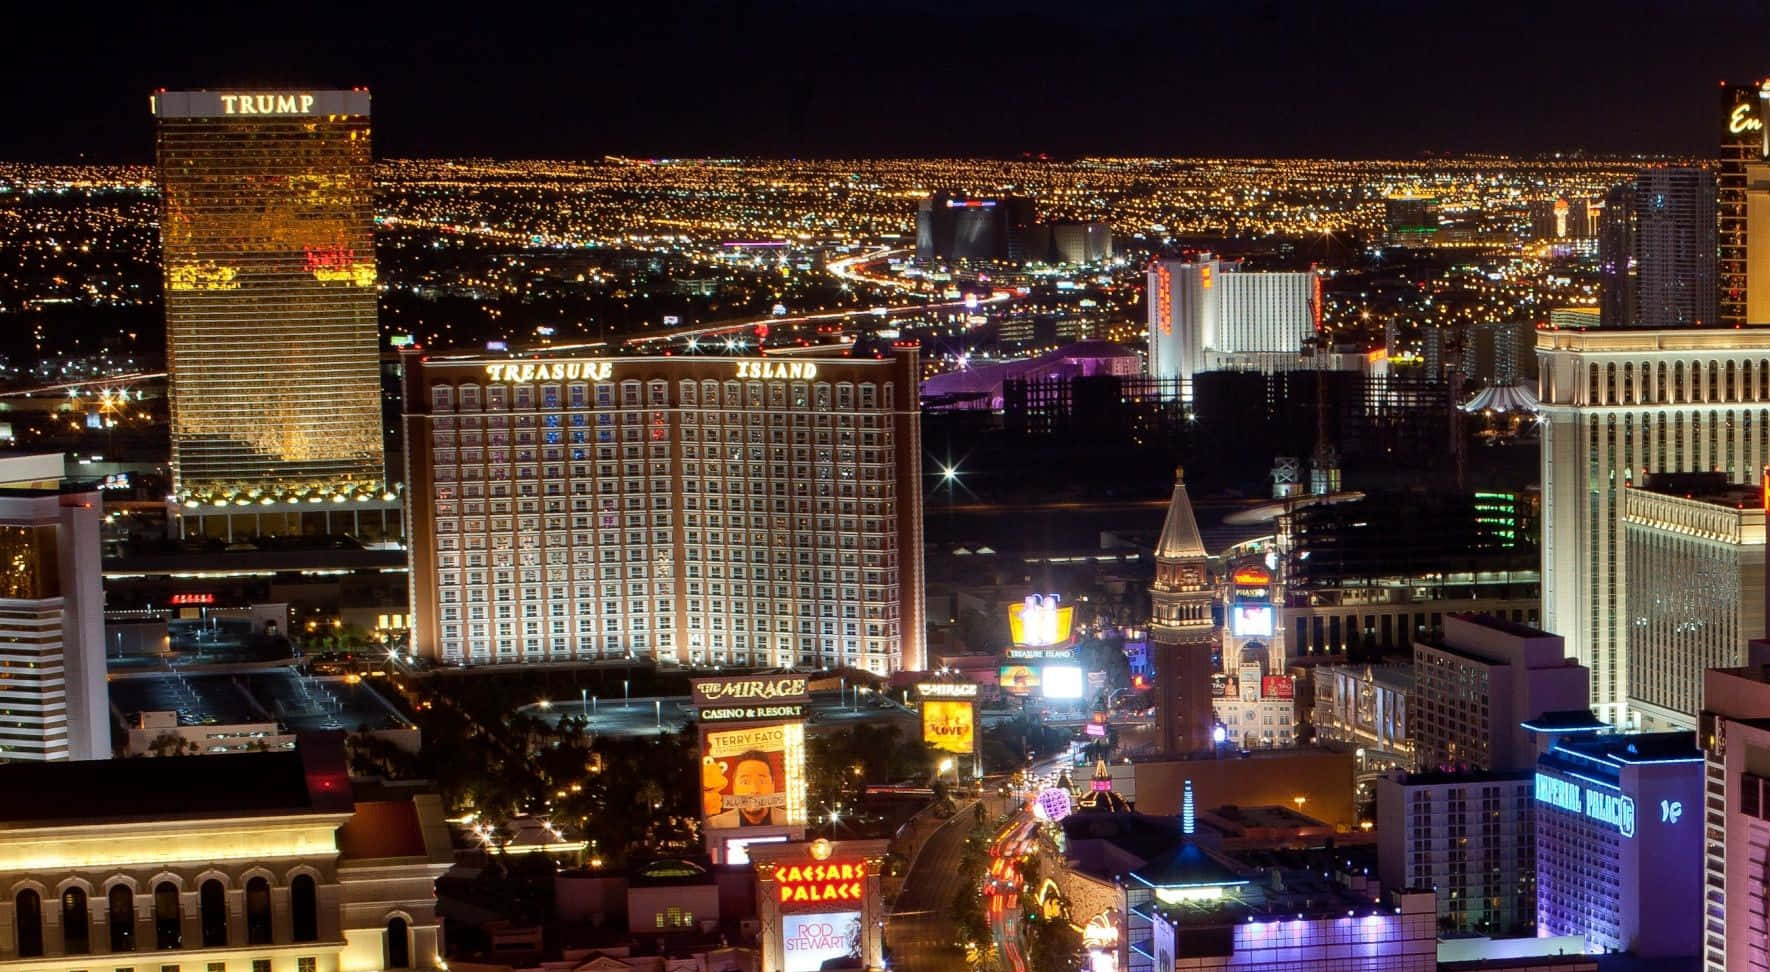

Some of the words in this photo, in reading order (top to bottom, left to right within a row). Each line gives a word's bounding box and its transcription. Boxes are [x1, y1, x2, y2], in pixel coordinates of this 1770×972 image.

[221, 95, 313, 114] TRUMP
[485, 362, 613, 382] TREASURE
[736, 361, 817, 379] ISLAND
[721, 680, 805, 699] MIRAGE
[702, 708, 744, 719] CASINO
[746, 709, 755, 718] &
[757, 706, 802, 717] RESORT
[715, 734, 751, 746] TERRY
[755, 730, 784, 741] FATO
[936, 726, 962, 736] LOVE
[1535, 773, 1582, 813] IMPERIAL
[775, 863, 865, 882] CAESARS
[781, 883, 862, 902] PALACE
[798, 923, 833, 938] ROD
[786, 935, 845, 951] STEWART
